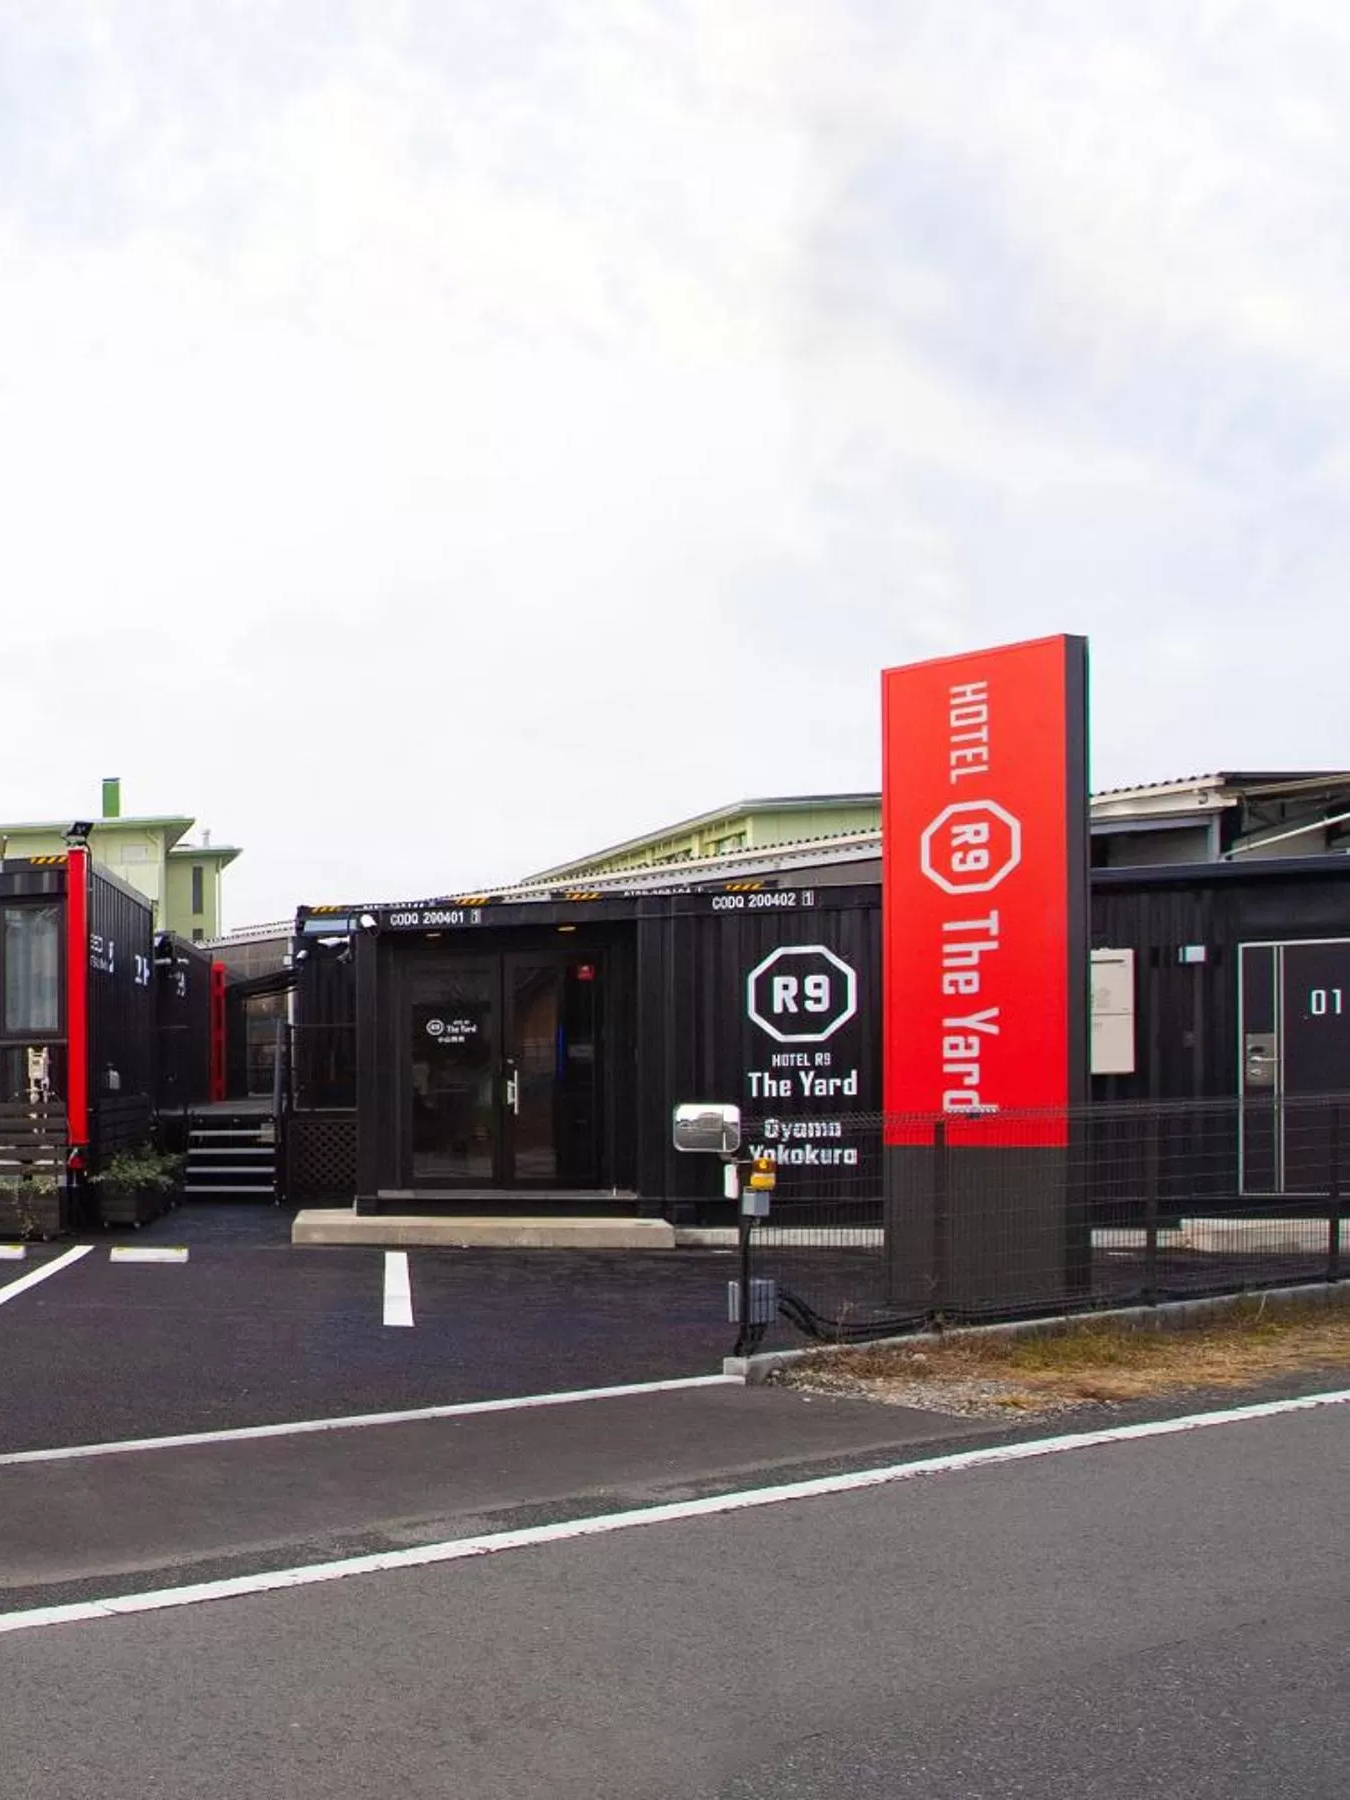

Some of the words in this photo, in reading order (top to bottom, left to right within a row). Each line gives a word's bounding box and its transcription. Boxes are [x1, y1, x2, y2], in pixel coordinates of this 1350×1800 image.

[949, 680, 990, 785] HOTEL
[951, 821, 991, 873] R9
[748, 893, 796, 908] 200402
[423, 909, 464, 924] 200401
[942, 908, 1000, 995] The
[773, 974, 830, 1014] R9
[1311, 989, 1342, 1014] 01
[772, 1053, 811, 1067] HOTEL
[814, 1052, 831, 1066] R9
[942, 1006, 1000, 1114] Yard
[747, 1072, 792, 1098] The
[798, 1069, 858, 1097] Yard
[764, 1119, 842, 1142] Oyama
